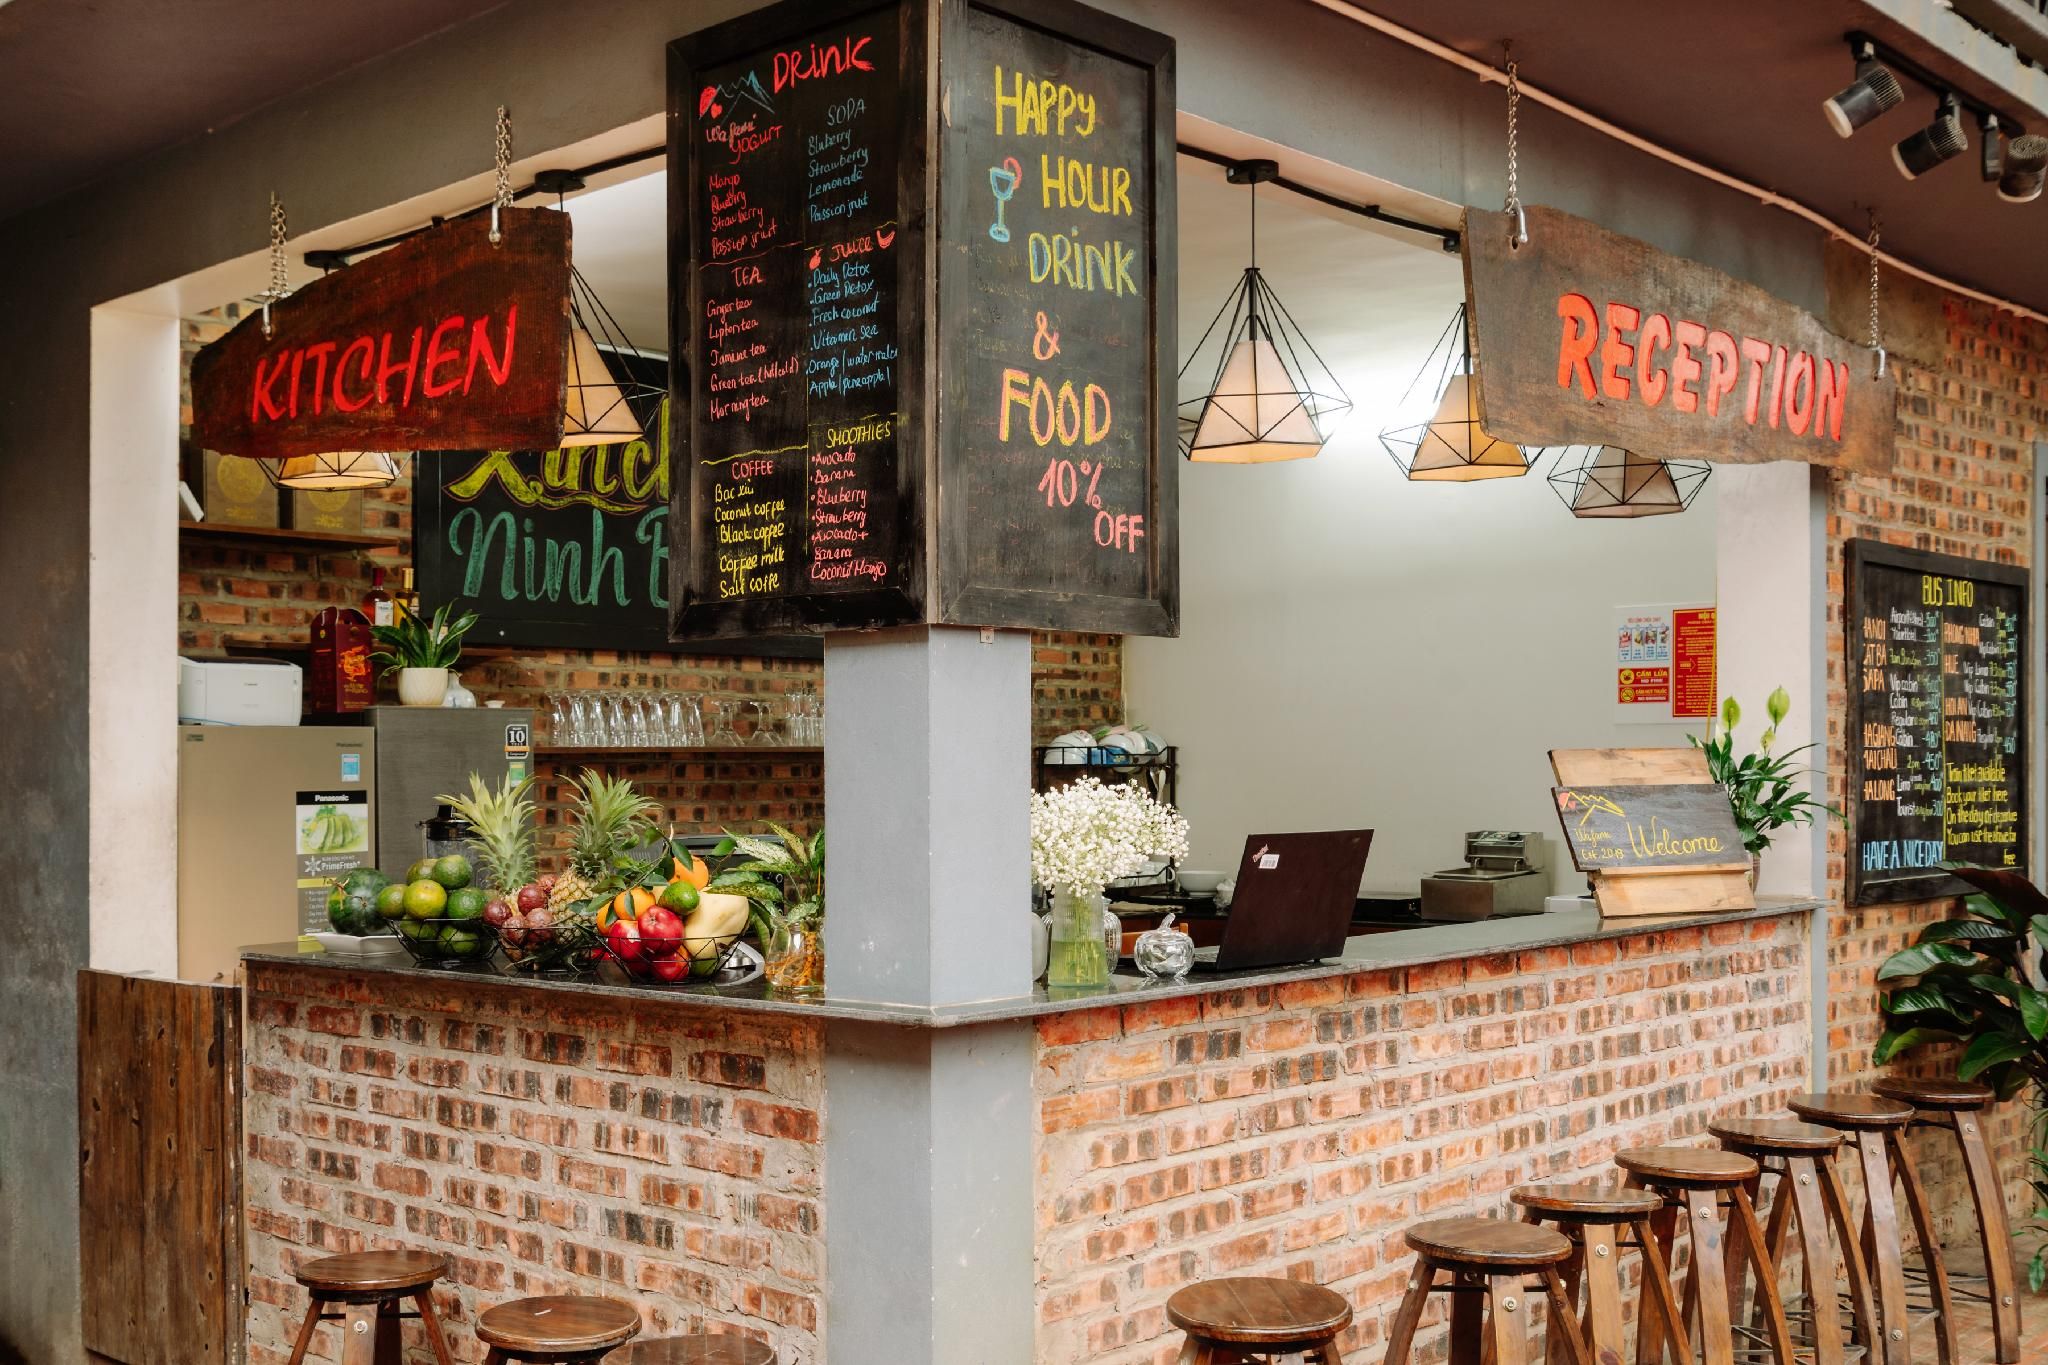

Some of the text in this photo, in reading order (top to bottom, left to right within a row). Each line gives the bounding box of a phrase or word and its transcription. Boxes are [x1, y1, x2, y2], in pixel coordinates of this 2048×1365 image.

[827, 97, 867, 127] SODA
[808, 147, 869, 178] Strawberry
[709, 173, 741, 195] Mango
[808, 164, 864, 199] Lemonade
[1041, 153, 1134, 217] HOUR
[810, 204, 846, 224] Passion
[731, 266, 765, 287] TEA
[735, 297, 753, 312] tea
[812, 305, 839, 326] Fresh
[709, 317, 759, 347] Lipton tea
[1032, 310, 1060, 360] &
[749, 343, 767, 357] tea
[251, 304, 518, 423] KITCHEN
[1557, 292, 1849, 441] RECEPTION
[711, 373, 737, 391] Green
[738, 371, 757, 386] tea
[749, 391, 769, 408] tea
[1000, 368, 1111, 447] FOOD
[732, 460, 774, 480] COFFEE
[1037, 457, 1103, 510] 10%
[715, 502, 752, 523] Coconut
[815, 507, 867, 528] Strawberry
[720, 523, 753, 544] Black
[1093, 510, 1144, 553] OFF
[448, 507, 633, 608] Ninh
[760, 545, 785, 567] milk
[1922, 575, 1975, 607] BUS INFO
[509, 730, 526, 743] 10
[314, 794, 350, 802] Panasonic
[1626, 815, 1724, 858] Welcome
[1863, 840, 1944, 871] HAVE A NICE DAY
